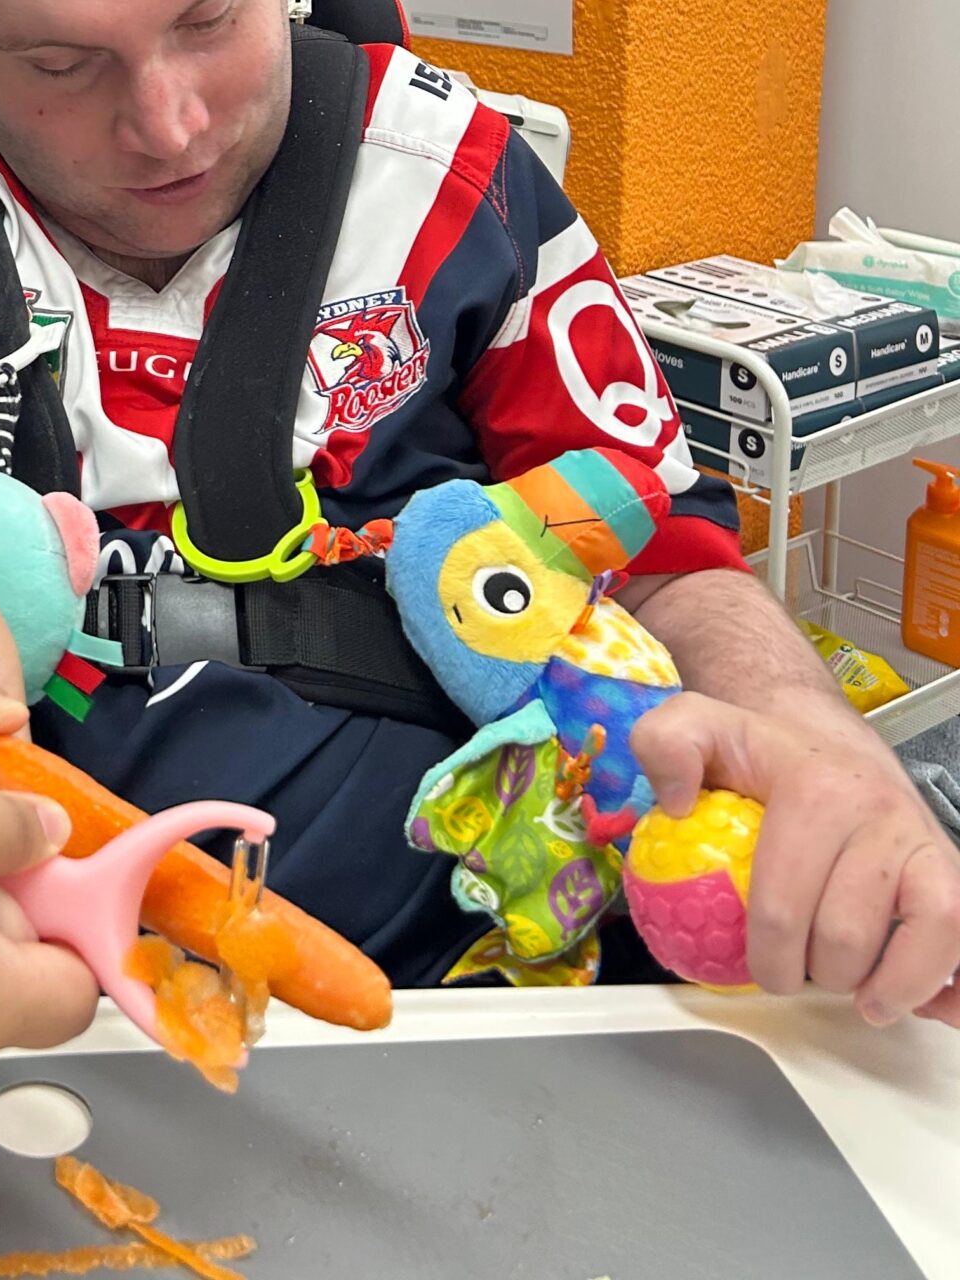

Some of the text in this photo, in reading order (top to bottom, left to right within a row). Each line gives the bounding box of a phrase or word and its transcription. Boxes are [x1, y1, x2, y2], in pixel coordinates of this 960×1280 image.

[409, 60, 452, 101] IS
[920, 331, 929, 346] M
[871, 340, 905, 358] Handicare
[96, 350, 193, 381] UG
[835, 354, 842, 369] S
[737, 367, 749, 383] S
[782, 364, 818, 382] Handicare
[746, 435, 757, 451] S
